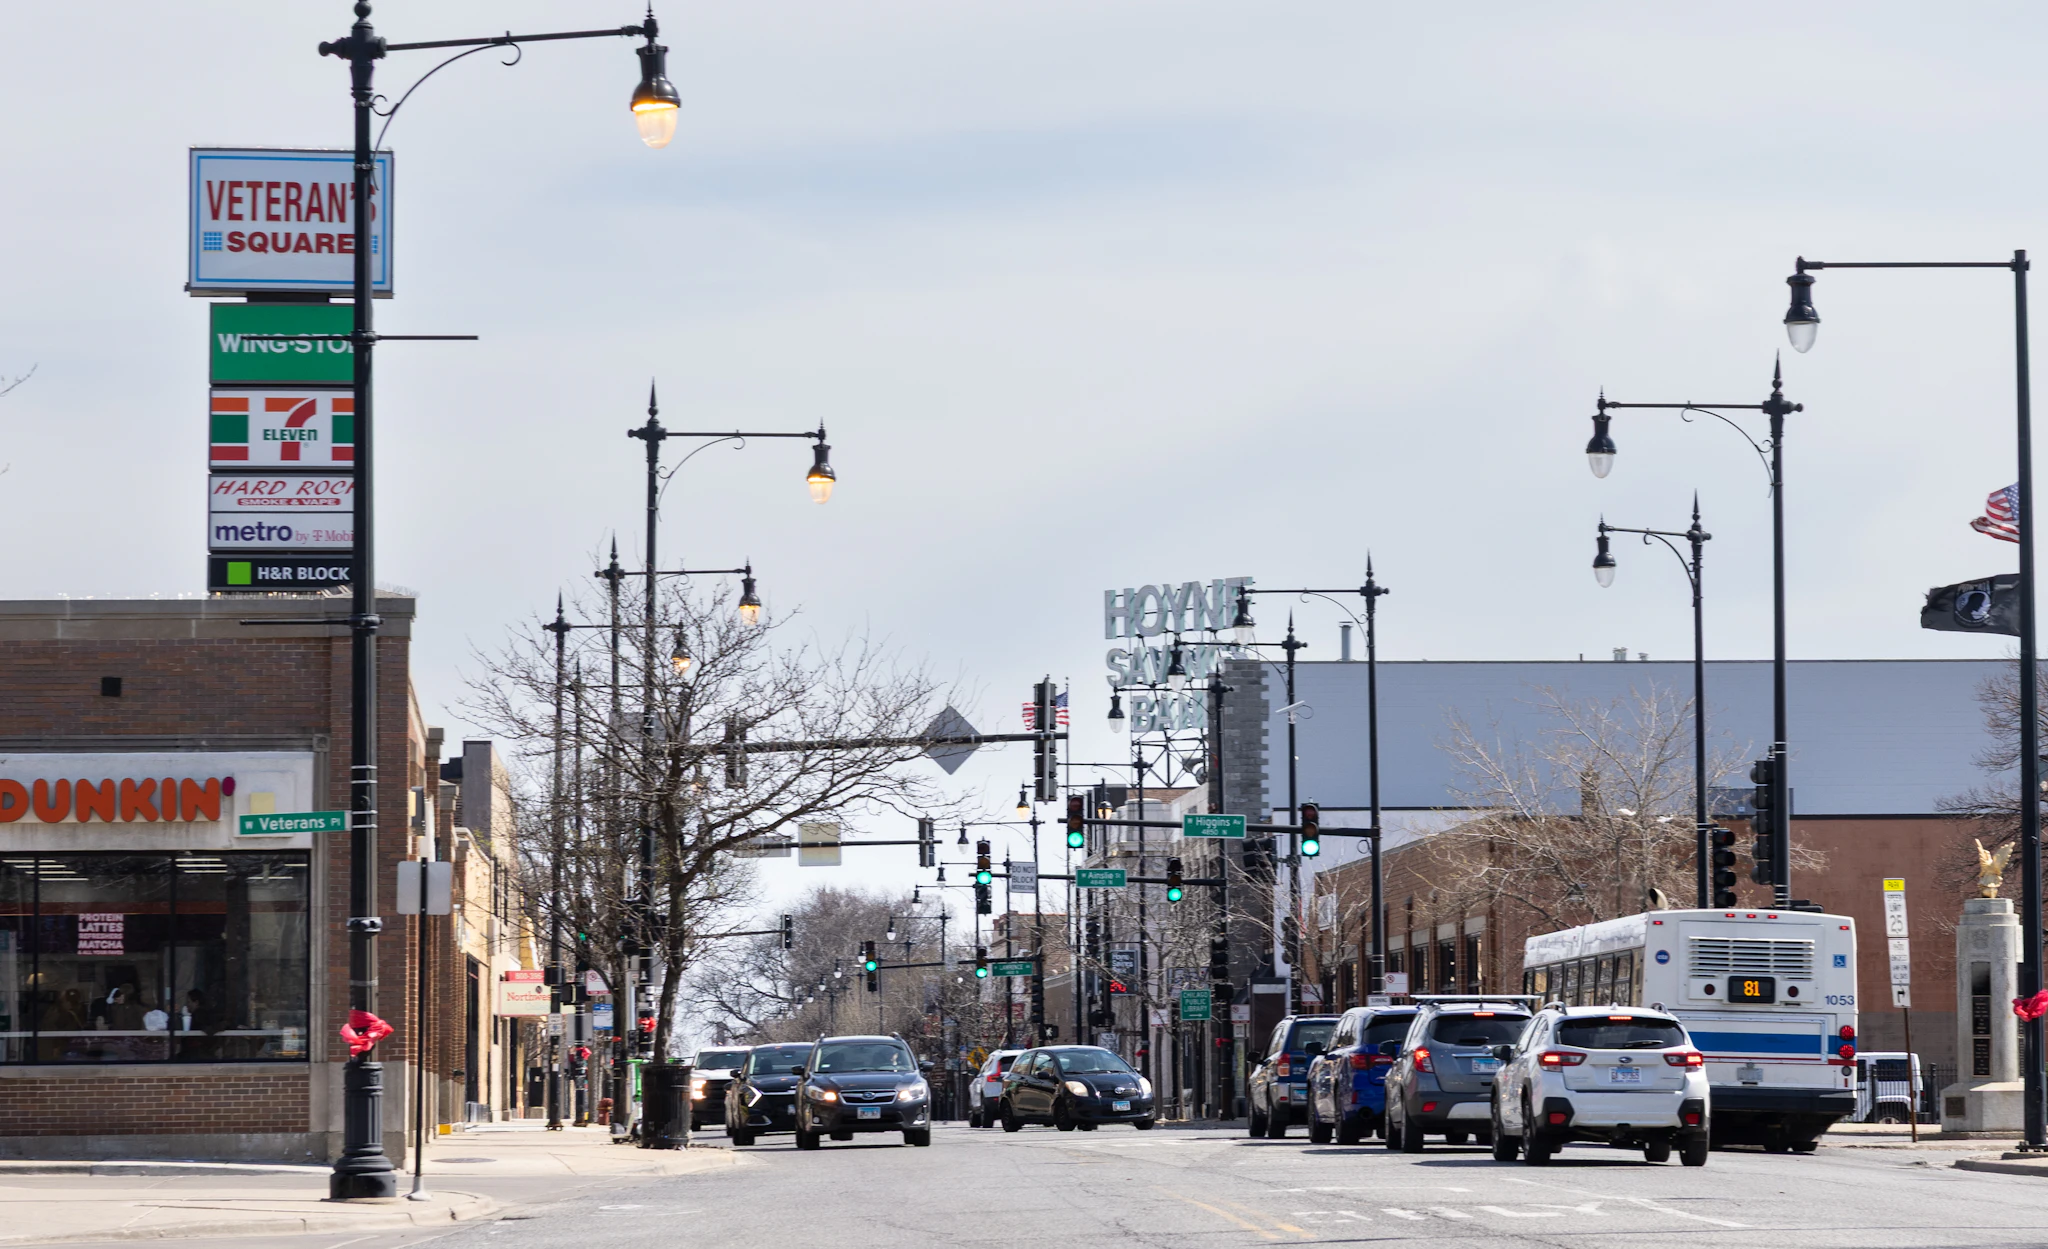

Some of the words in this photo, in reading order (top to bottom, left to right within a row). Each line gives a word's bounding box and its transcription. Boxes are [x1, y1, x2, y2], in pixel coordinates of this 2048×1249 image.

[227, 231, 355, 254] SQUARE
[213, 480, 287, 495] HARD
[215, 521, 293, 542] metro
[295, 530, 310, 545] by
[257, 567, 293, 581] H&R
[297, 567, 350, 581] BLOCK
[1133, 691, 1208, 733] BAN
[0, 776, 236, 823] DUNKIN'
[244, 821, 254, 830] W
[259, 817, 326, 831] Veterans
[330, 818, 341, 827] Pl
[1195, 817, 1231, 829] Higgins
[1012, 865, 1022, 873] DO
[1022, 866, 1036, 874] NOT
[1012, 875, 1035, 884] BLOCK
[1088, 872, 1114, 880] Ainslie
[78, 913, 124, 921] PROTEIN
[78, 922, 124, 932] LATTES
[1889, 914, 1904, 934] 25
[77, 940, 124, 949] MATCHA
[1743, 980, 1761, 997] 81
[507, 990, 551, 1002] Northwes
[1825, 995, 1855, 1006] 1053
[1184, 1005, 1208, 1013] LIBRARY
